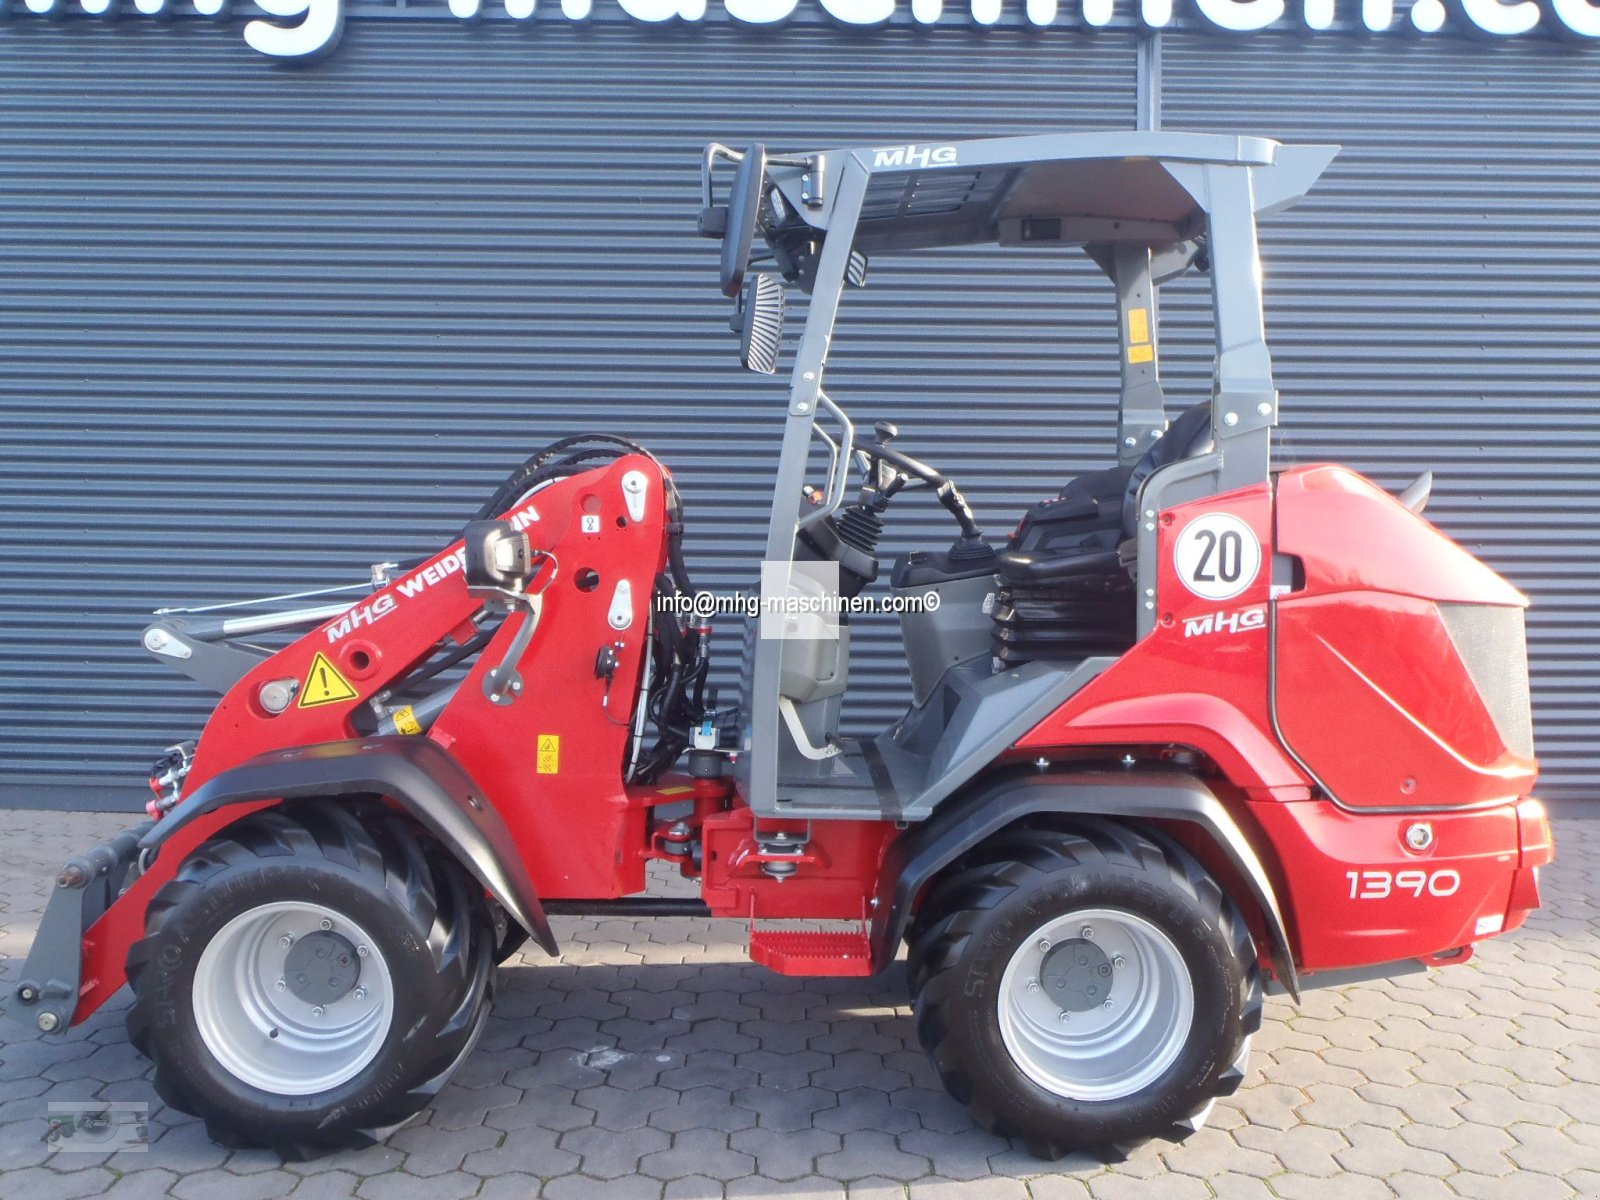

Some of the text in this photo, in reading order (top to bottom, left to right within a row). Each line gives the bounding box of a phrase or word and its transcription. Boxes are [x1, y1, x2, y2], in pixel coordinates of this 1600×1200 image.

[873, 145, 958, 168] MHG
[1193, 529, 1242, 583] 20
[322, 593, 398, 643] MHG
[1182, 608, 1267, 637] MHG
[1346, 869, 1461, 899] 1390
